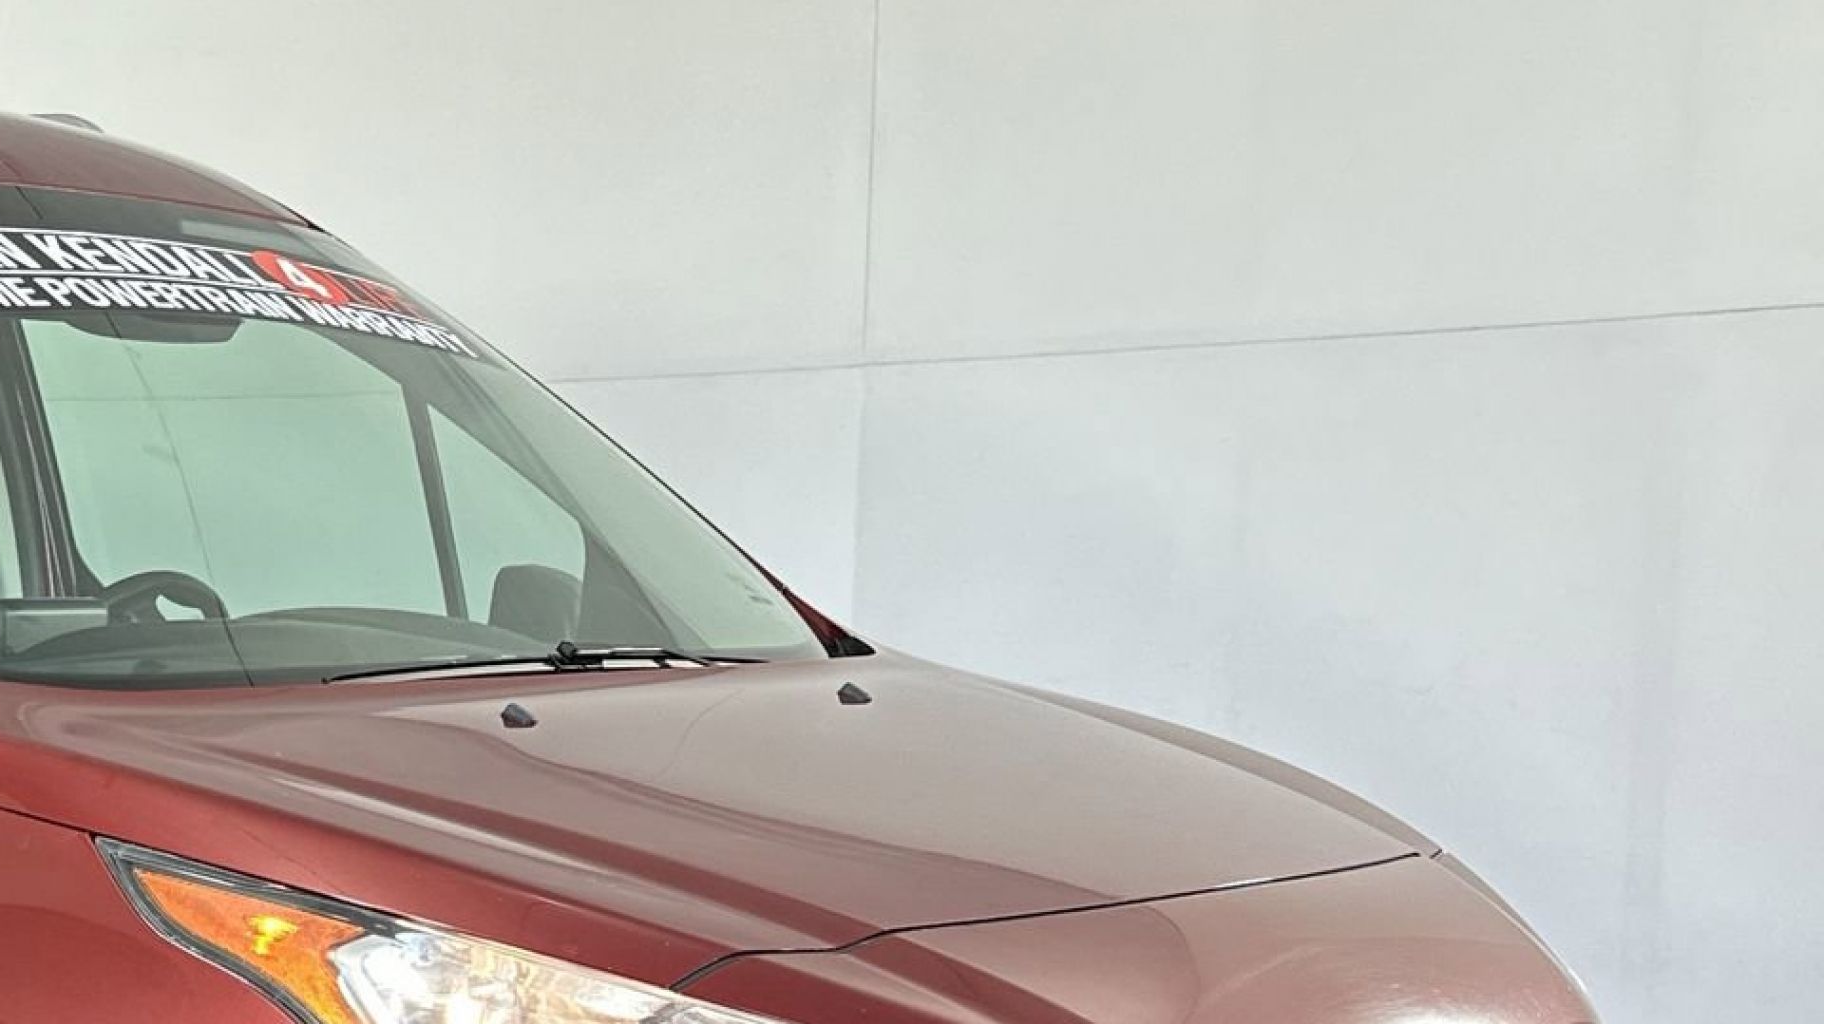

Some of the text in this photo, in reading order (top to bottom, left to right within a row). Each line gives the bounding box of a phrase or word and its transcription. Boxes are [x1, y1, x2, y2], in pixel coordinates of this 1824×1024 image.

[23, 233, 283, 288] KENDALL
[276, 257, 332, 298] 4
[32, 277, 304, 321] POWERTRAIN
[285, 296, 480, 358] WARRANTY
